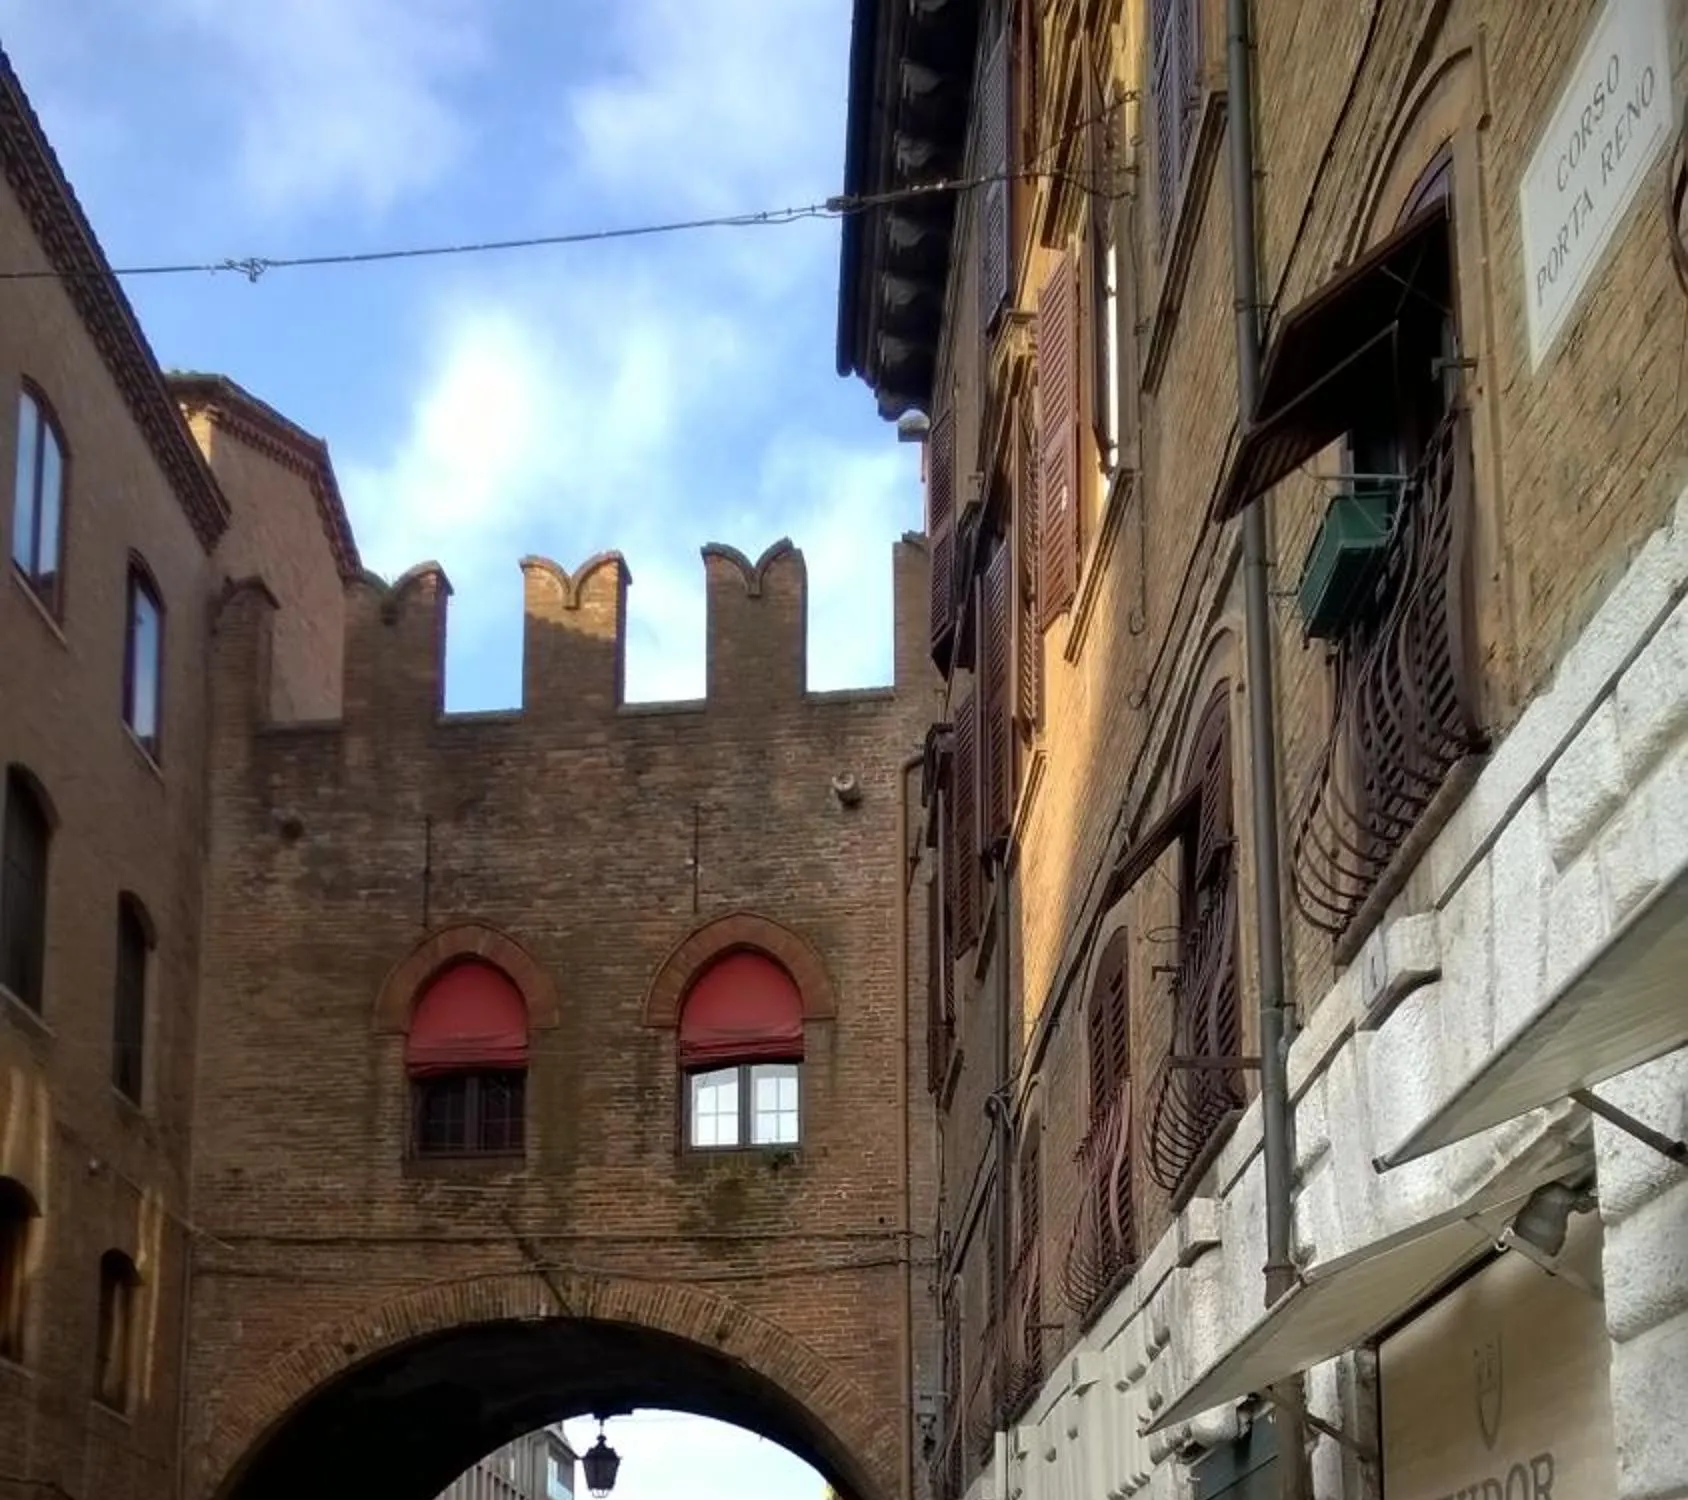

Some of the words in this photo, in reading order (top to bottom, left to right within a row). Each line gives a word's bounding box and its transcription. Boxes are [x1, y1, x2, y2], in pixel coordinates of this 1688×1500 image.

[1536, 186, 1594, 306] PORTA
[1601, 65, 1655, 186] RENO
[1556, 53, 1620, 192] CORSO
